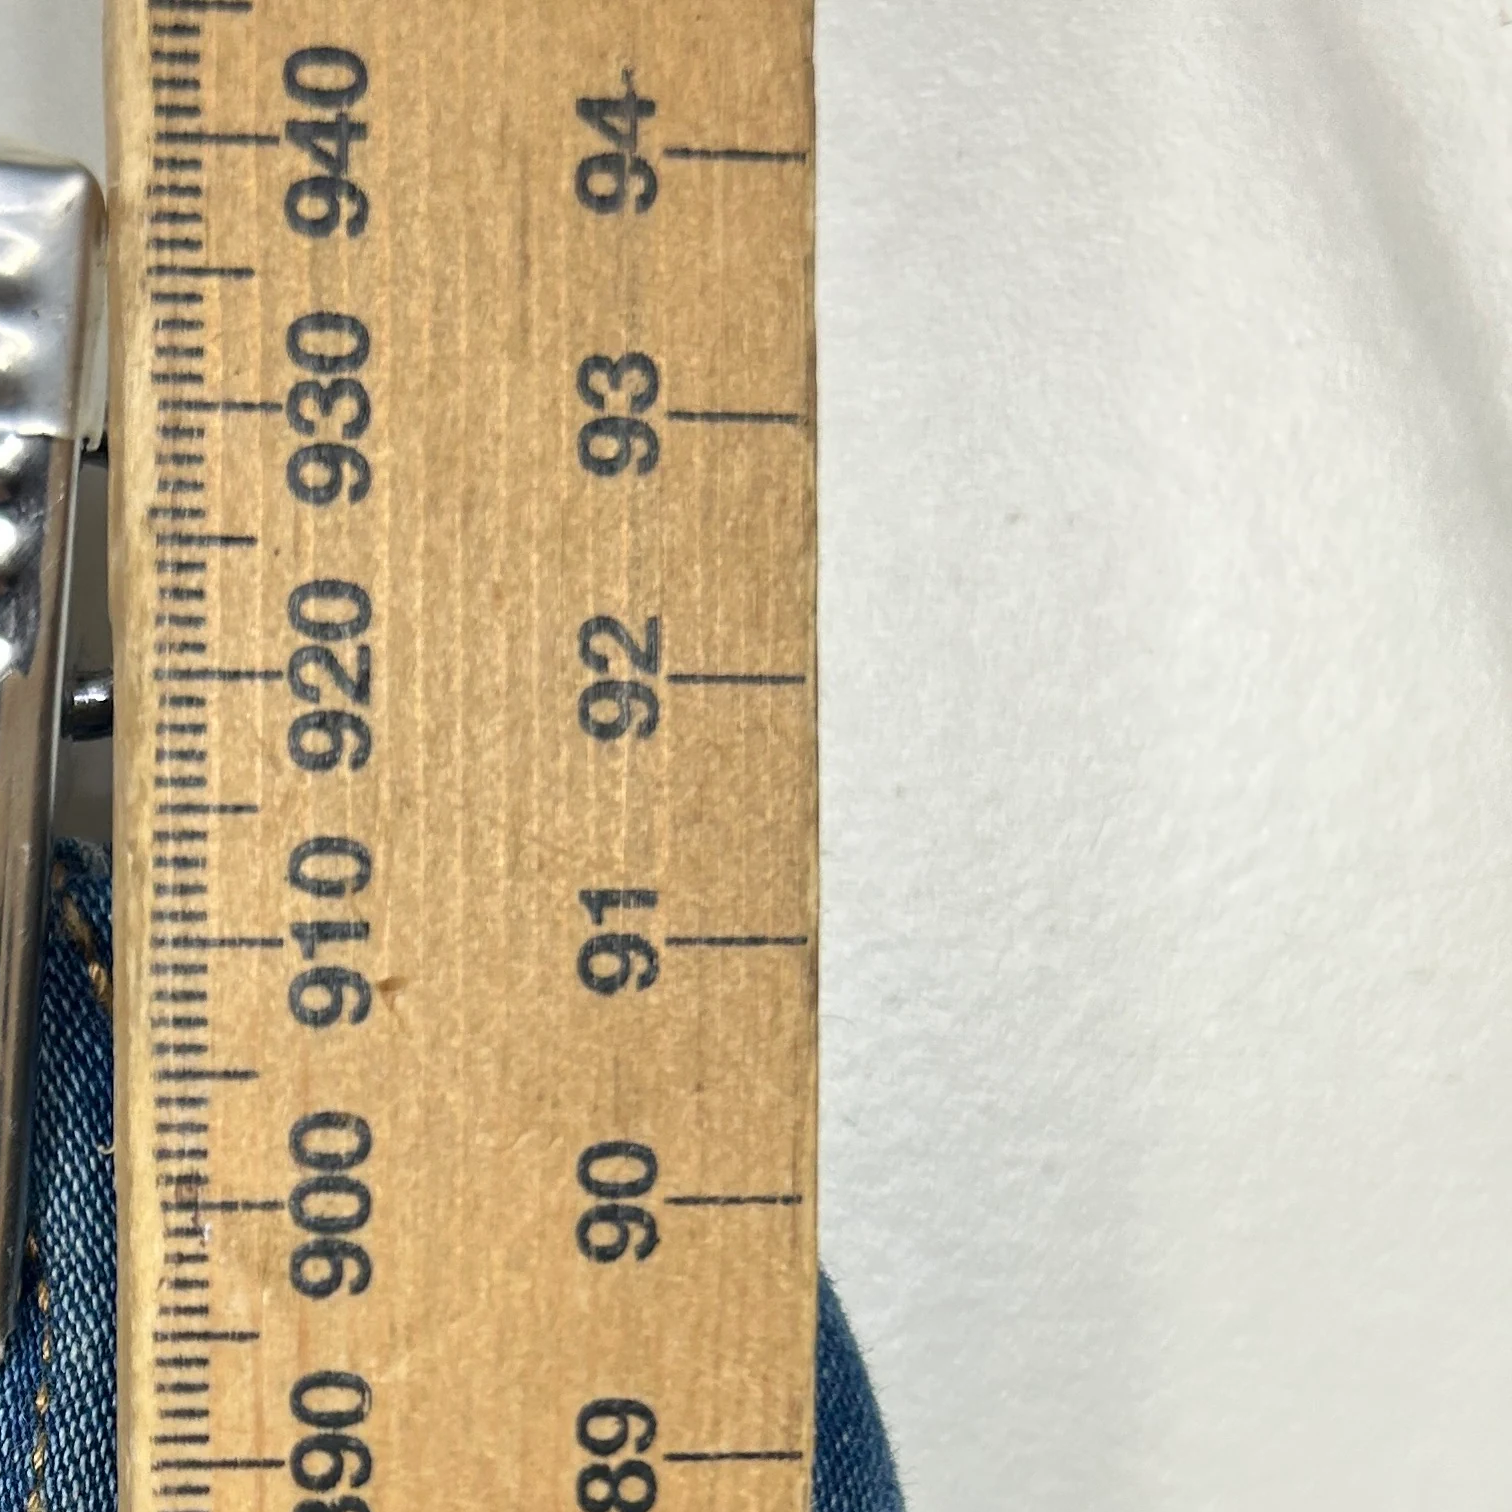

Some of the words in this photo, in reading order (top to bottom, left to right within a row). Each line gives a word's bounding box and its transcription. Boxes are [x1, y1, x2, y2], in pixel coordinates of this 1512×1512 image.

[283, 46, 369, 238] 940
[575, 90, 658, 214] 94
[287, 310, 371, 505] 930
[577, 352, 660, 476] 93
[289, 579, 372, 772] 920
[578, 615, 660, 741] 92
[287, 835, 372, 1029] 910
[579, 888, 659, 996] 91
[290, 1111, 372, 1299] 900
[577, 1141, 661, 1264] 90
